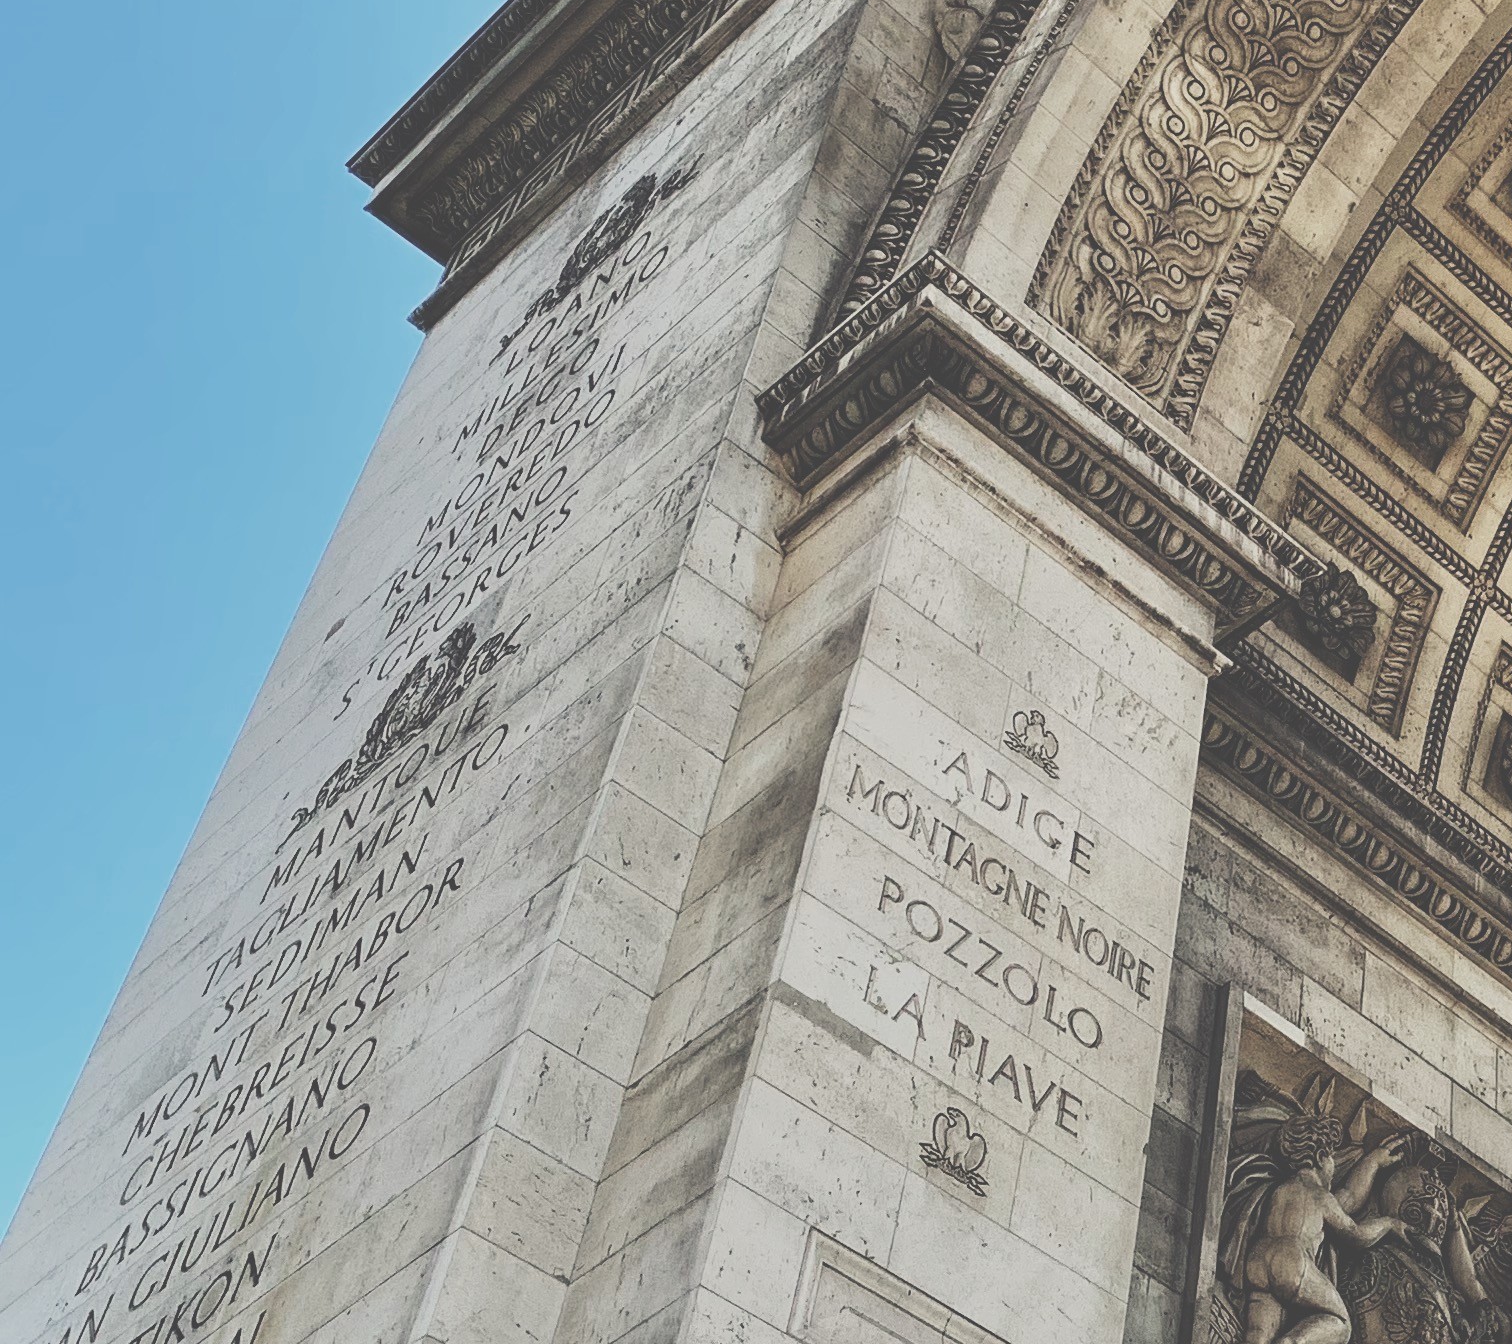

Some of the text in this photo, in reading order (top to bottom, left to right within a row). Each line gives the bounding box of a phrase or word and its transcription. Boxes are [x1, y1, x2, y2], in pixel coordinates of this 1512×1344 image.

[452, 245, 670, 454] MILLESIMO
[503, 231, 651, 378] LOANO
[381, 389, 616, 610] ROVEREDO
[417, 343, 626, 546] MONDOVI
[385, 467, 567, 640] BASSANO
[202, 724, 508, 997] TAGLIAMENTO
[260, 683, 497, 905] MANTOUE
[846, 764, 1155, 1002] MONTAGNE NOIRE
[942, 751, 1096, 875] ADIGE
[122, 858, 464, 1156] MONT THABOR
[214, 833, 428, 1033] SEDIMAN
[878, 875, 1103, 1050] POZZOLO
[120, 951, 410, 1205] CHEBREISSE
[863, 965, 1084, 1138] LA PIAVE
[75, 1037, 377, 1296] BASSIGNANO
[129, 1103, 370, 1312] GIULIANO
